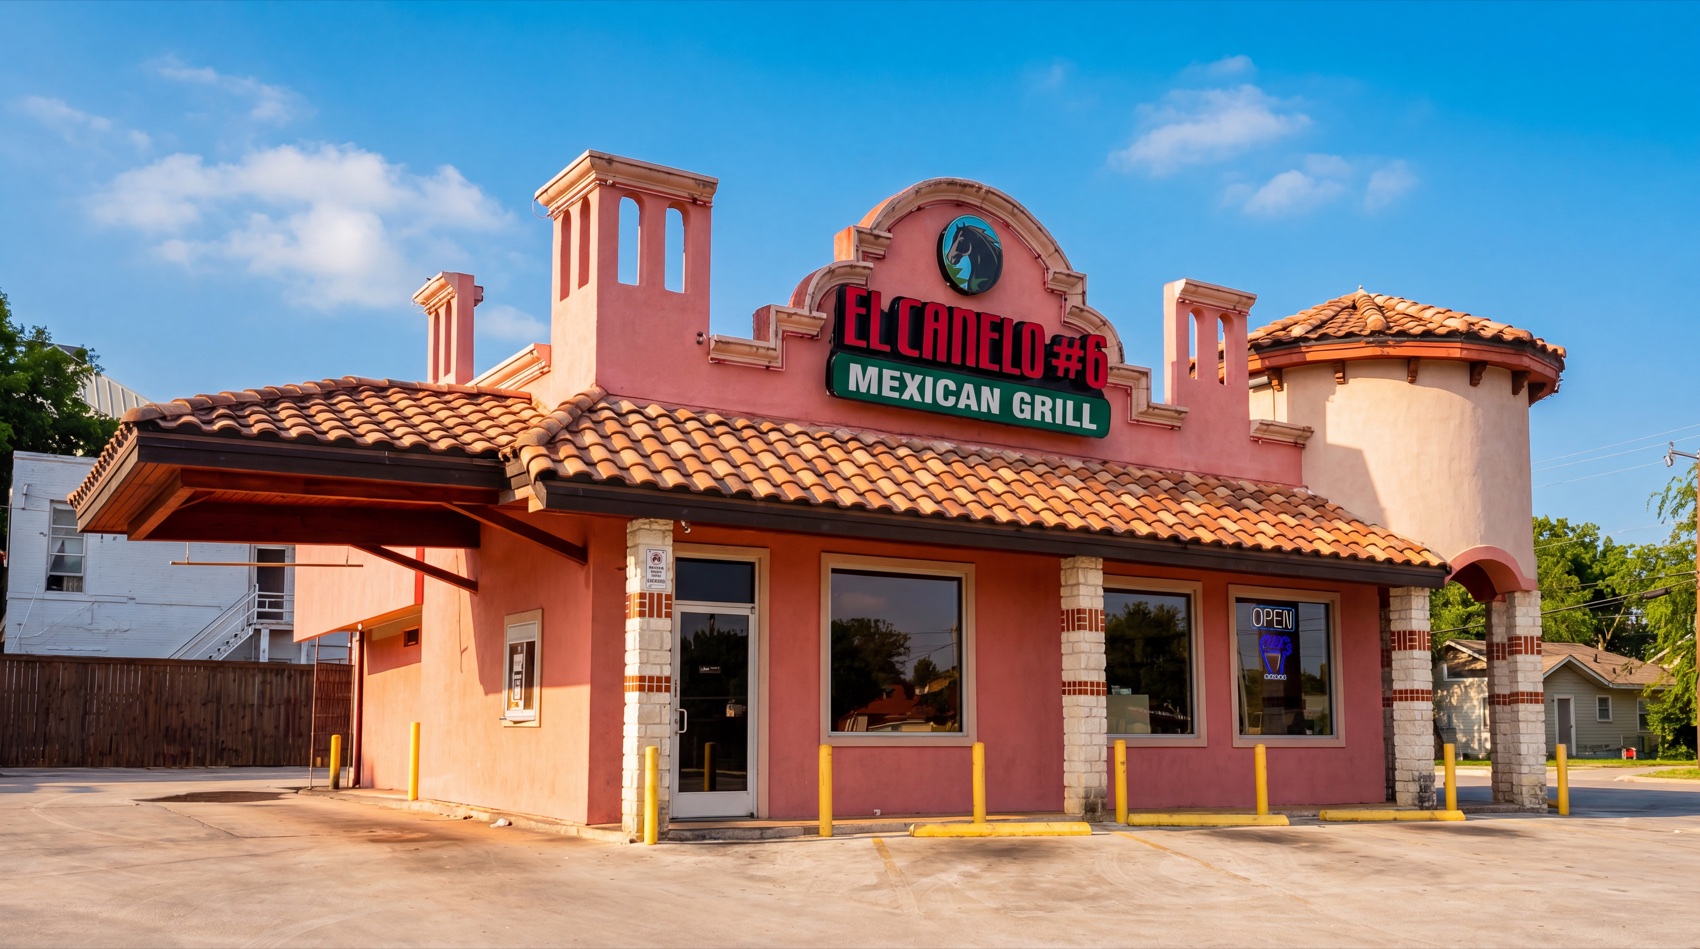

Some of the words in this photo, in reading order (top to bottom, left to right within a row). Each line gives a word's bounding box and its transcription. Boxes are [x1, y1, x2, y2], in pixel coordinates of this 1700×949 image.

[844, 286, 891, 352] EL
[898, 298, 1046, 379] CANELO
[1052, 334, 1109, 390] #6
[848, 363, 1001, 415] MEXICAN
[1012, 391, 1097, 430] GRILL
[1252, 607, 1293, 629] OPEN
